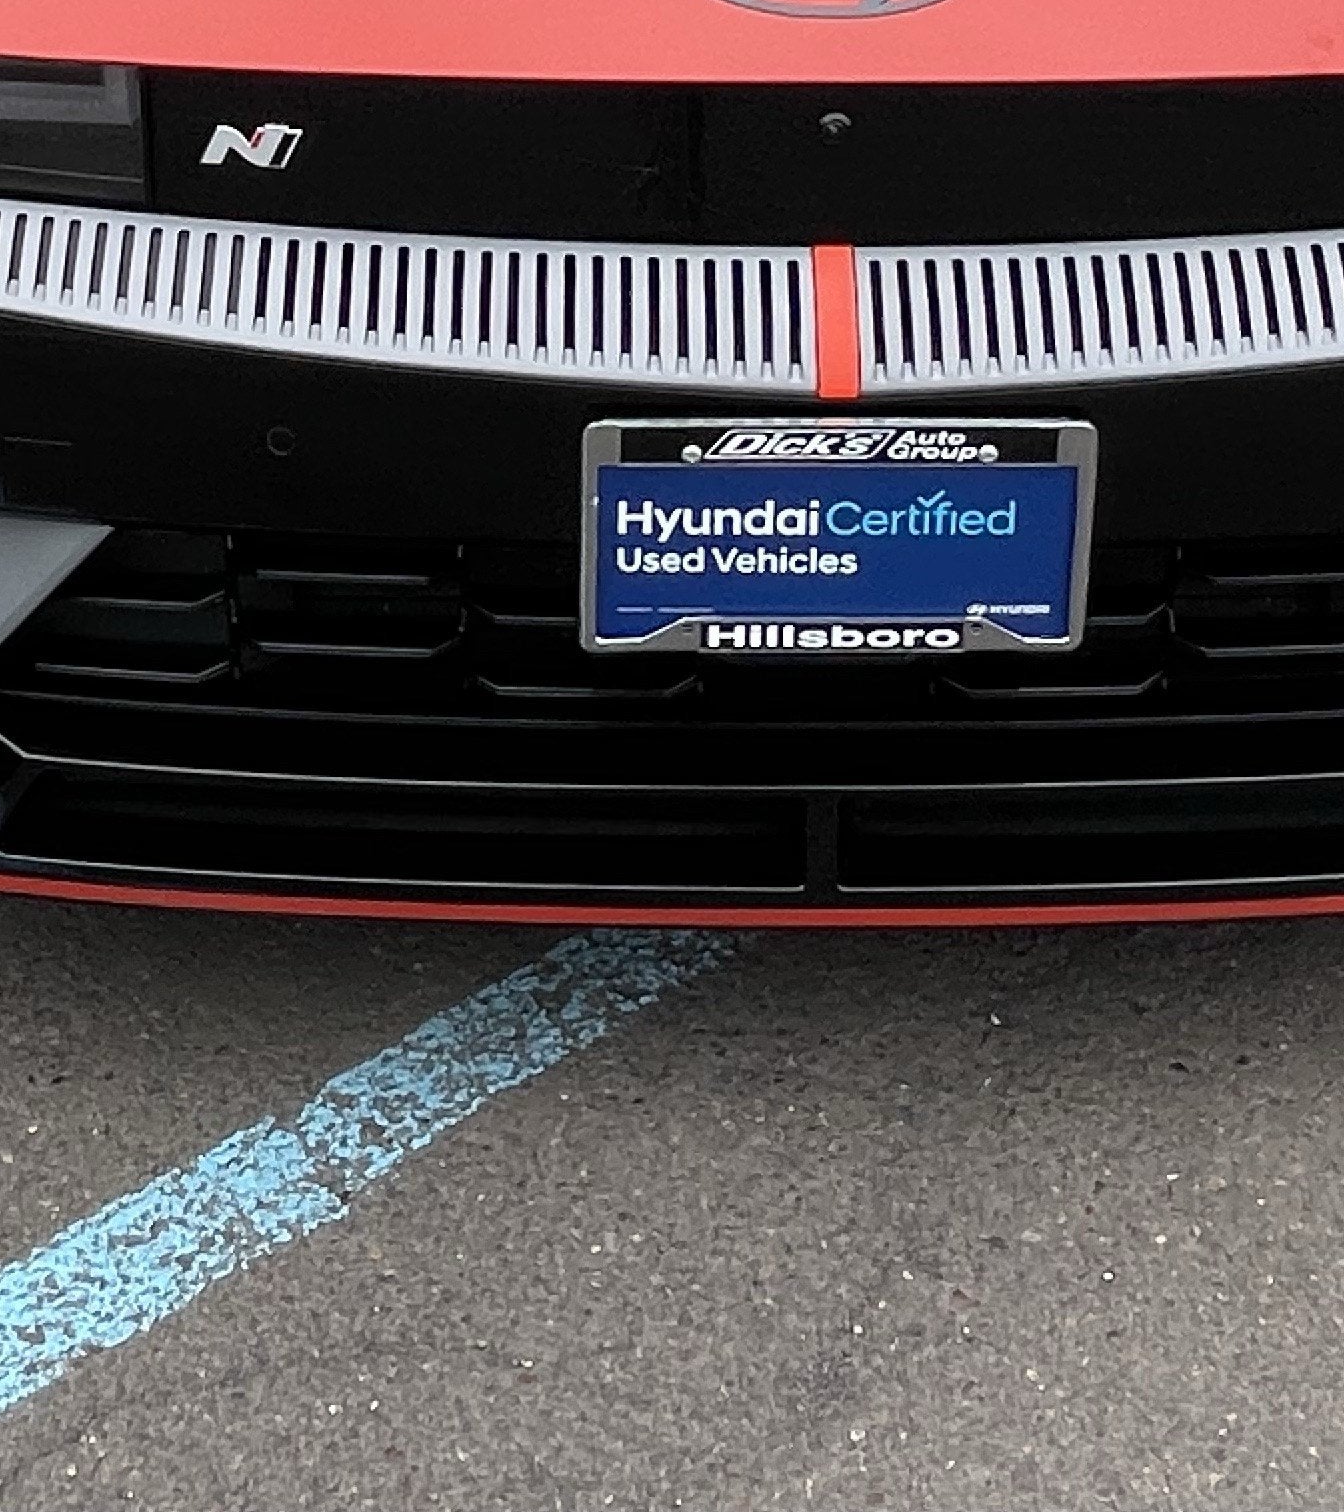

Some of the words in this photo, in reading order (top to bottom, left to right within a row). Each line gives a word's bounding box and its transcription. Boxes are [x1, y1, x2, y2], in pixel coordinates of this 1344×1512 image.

[896, 430, 967, 446] Auto
[887, 444, 978, 462] Group
[616, 500, 821, 543] Hyundai
[825, 491, 1017, 537] Certified
[616, 546, 706, 575] Used
[711, 546, 859, 575] Vehicles
[706, 623, 960, 649] Hillsboro
